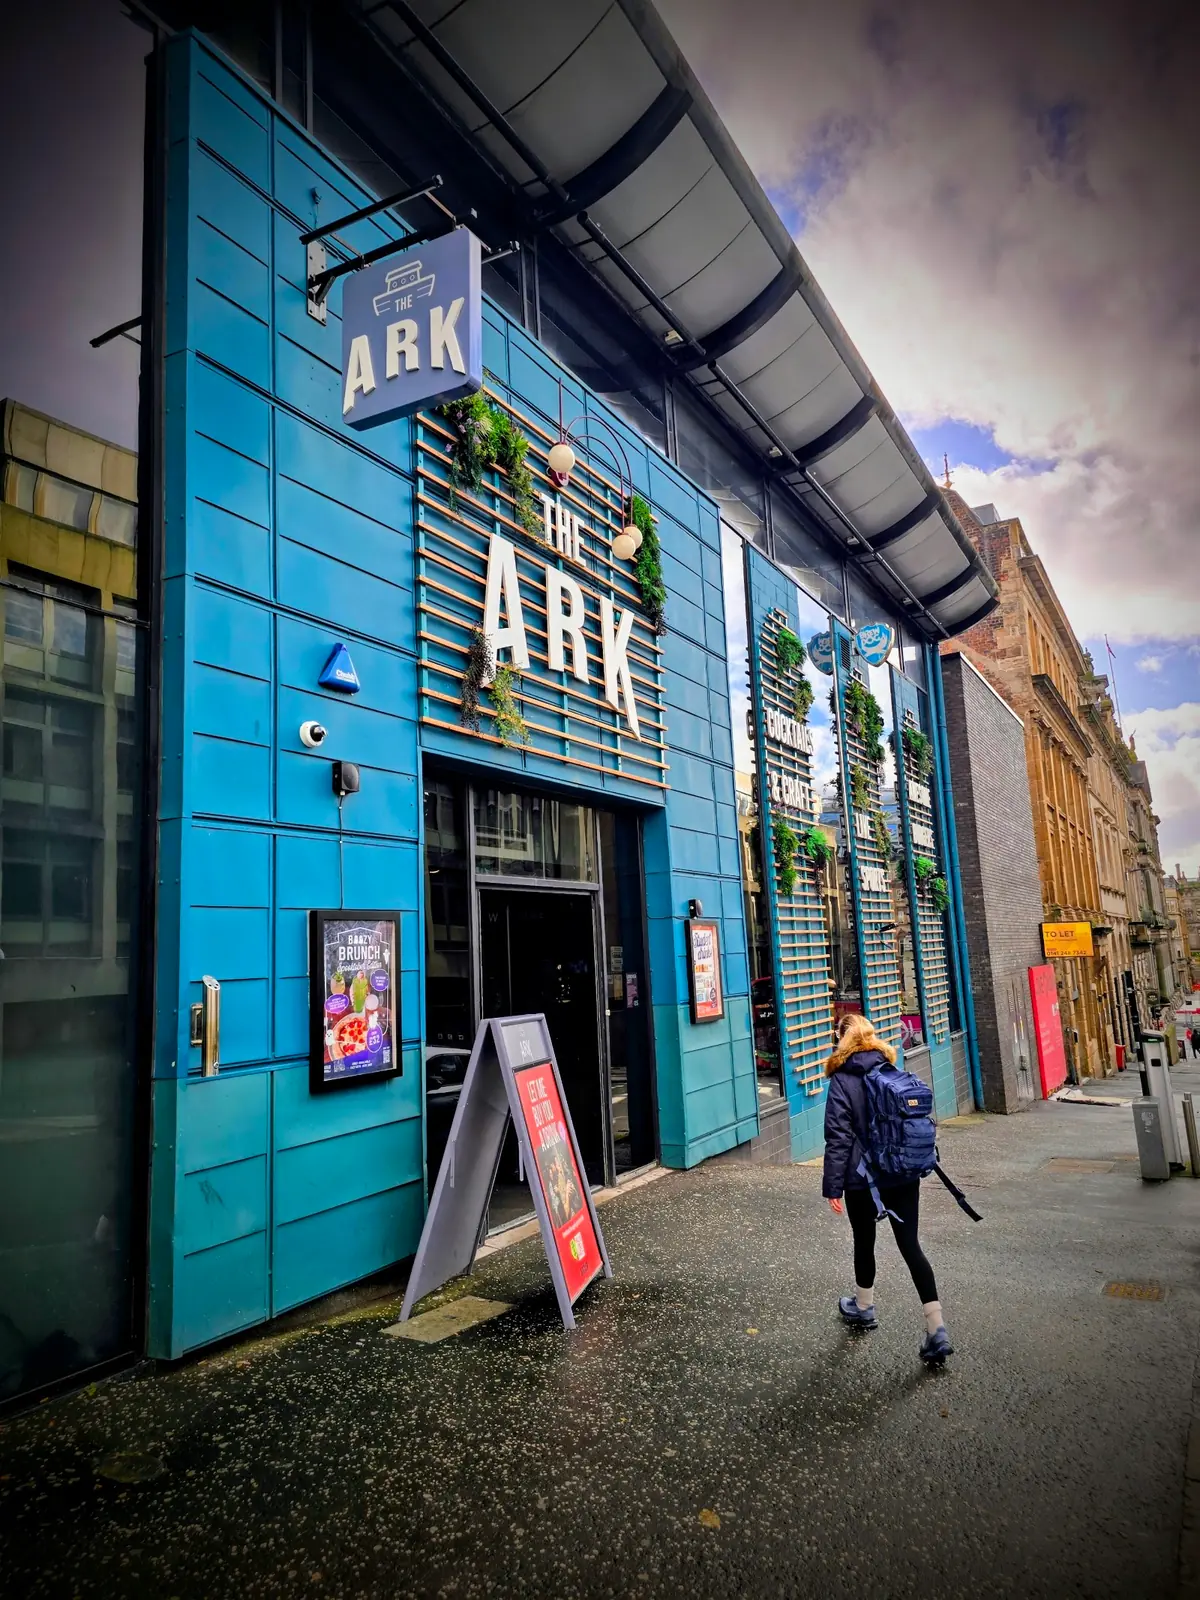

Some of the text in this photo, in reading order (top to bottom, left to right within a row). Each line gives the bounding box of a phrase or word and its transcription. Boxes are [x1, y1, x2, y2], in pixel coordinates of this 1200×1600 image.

[394, 296, 413, 313] THE
[342, 297, 466, 415] ARK
[539, 493, 587, 567] THE
[480, 533, 642, 742] ARK
[766, 707, 814, 756] COCKTAILS
[781, 774, 810, 810] CRAFT
[348, 934, 372, 945] BOOZY
[1059, 930, 1074, 938] LET
[338, 945, 380, 961] BRUNCH
